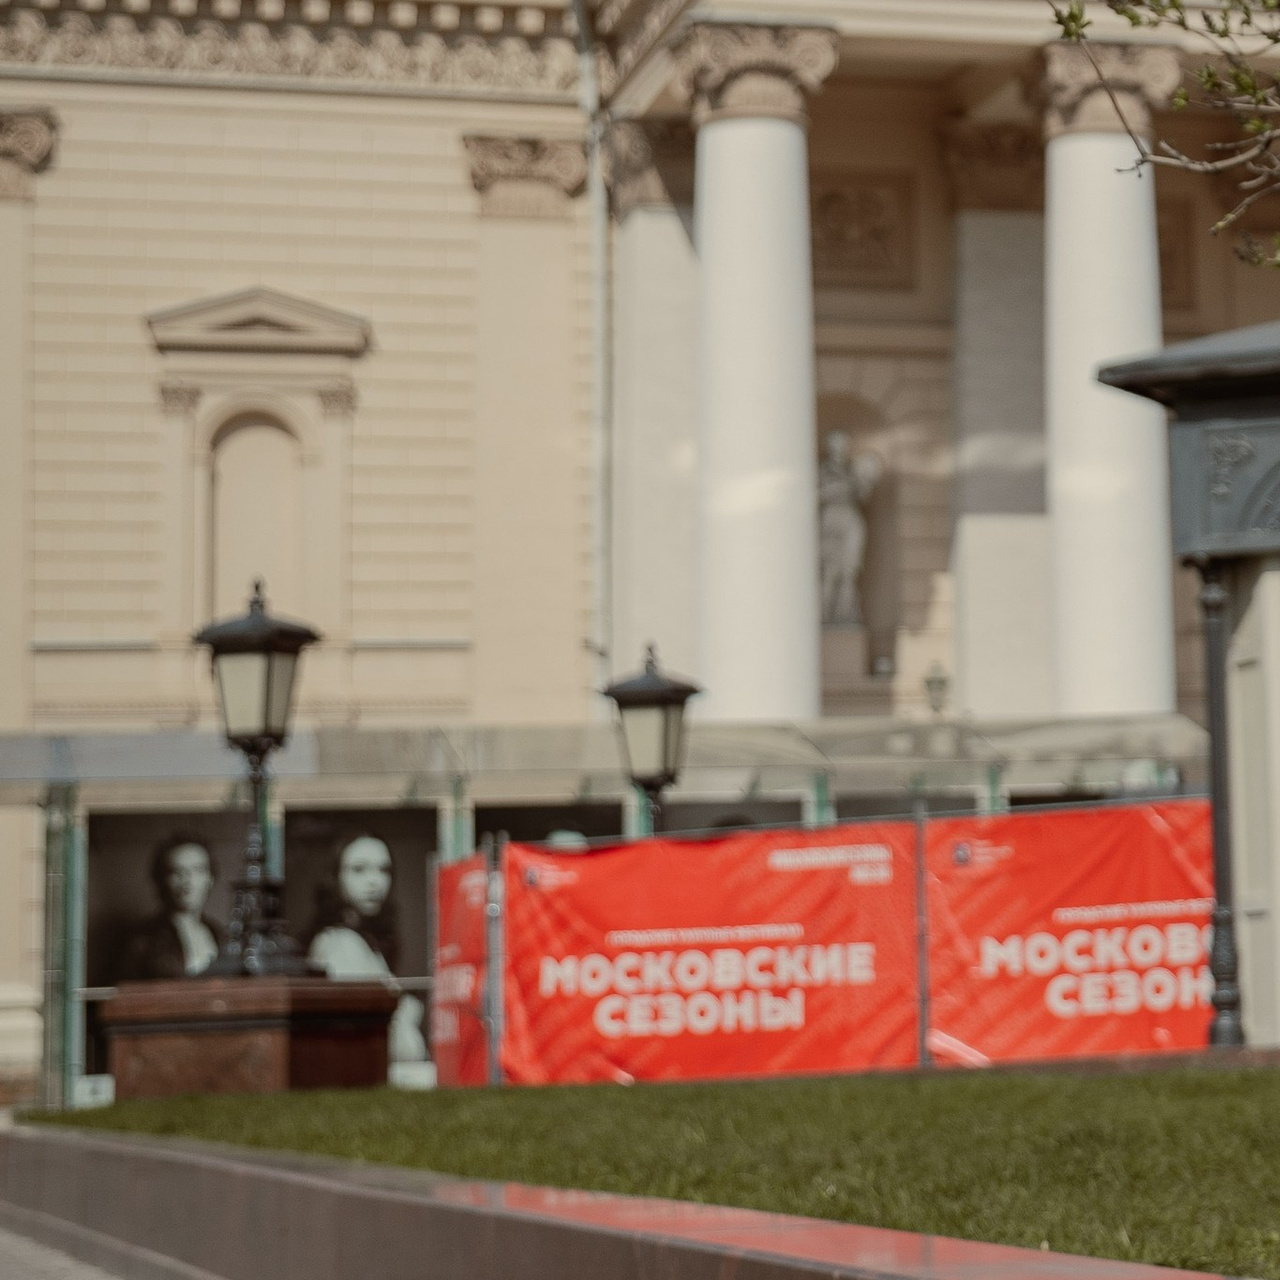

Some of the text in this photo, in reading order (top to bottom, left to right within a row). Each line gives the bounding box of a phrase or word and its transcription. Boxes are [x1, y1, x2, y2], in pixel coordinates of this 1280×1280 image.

[539, 942, 876, 998] МОСКОВСКИЕ
[980, 922, 1214, 979] МОСКОВ
[594, 988, 806, 1037] СЕЗОНЫ
